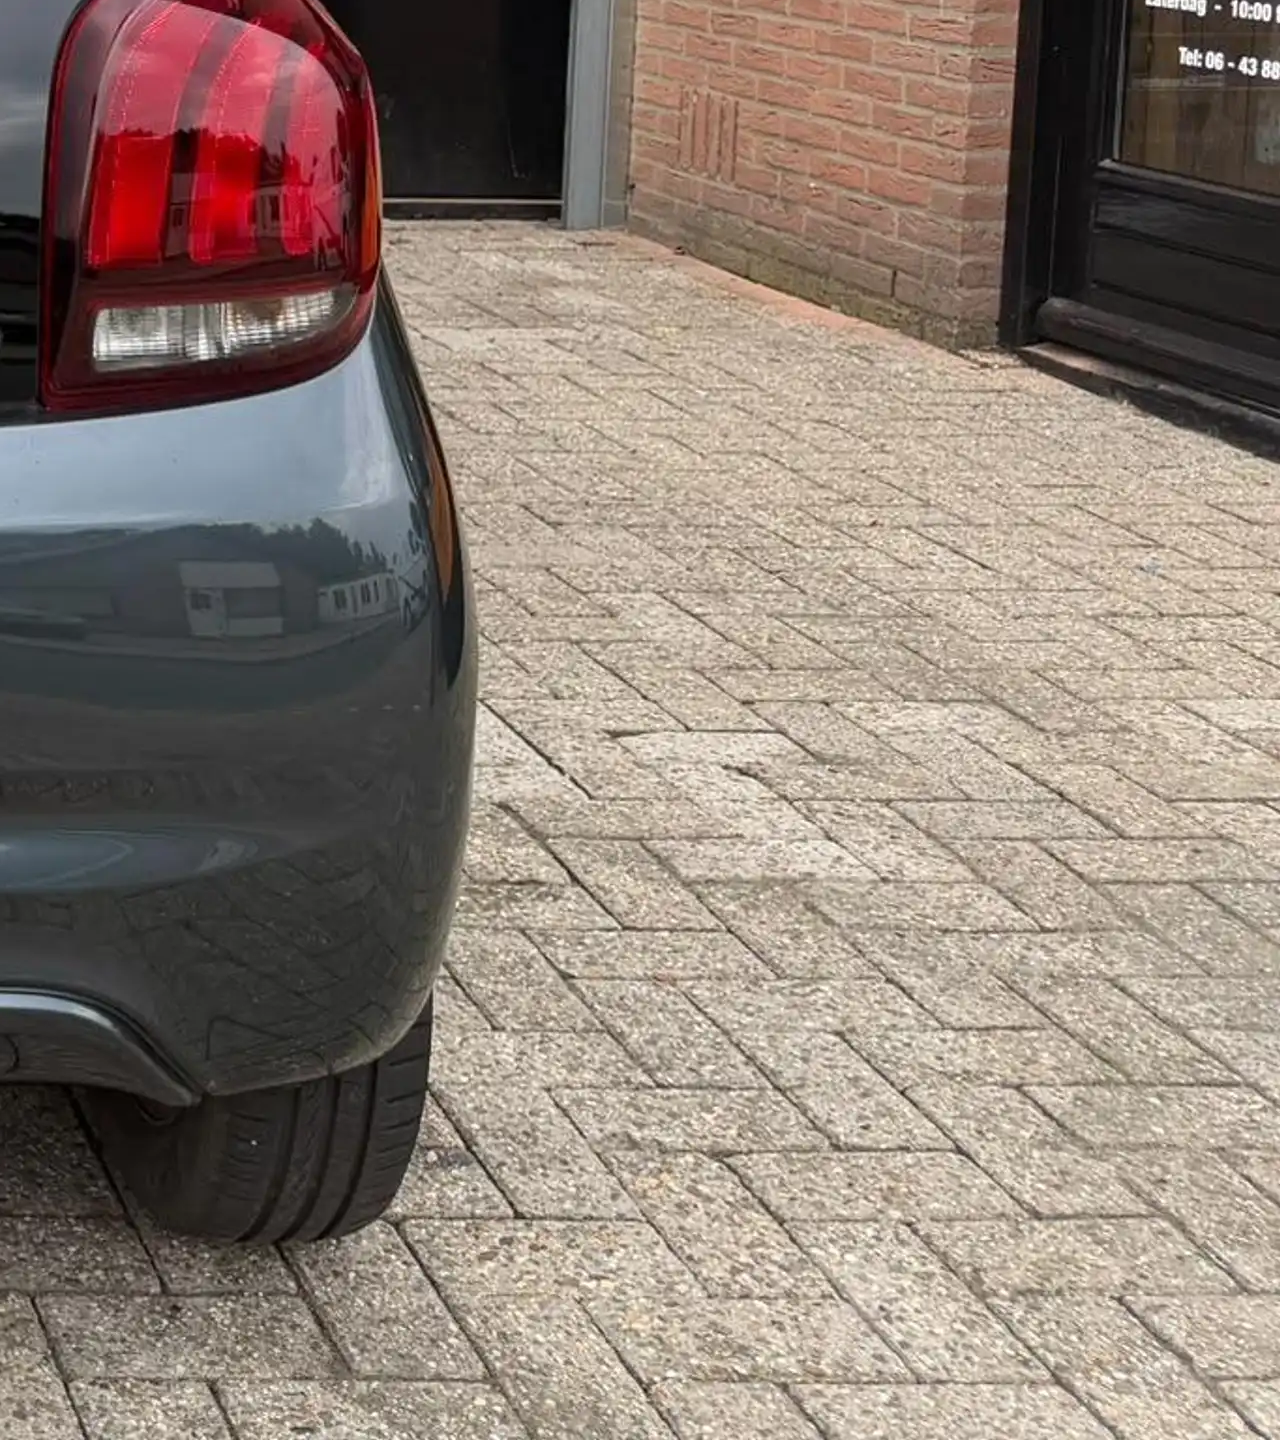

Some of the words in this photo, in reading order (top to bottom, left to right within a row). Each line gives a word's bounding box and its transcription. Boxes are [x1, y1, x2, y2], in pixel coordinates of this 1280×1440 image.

[1178, 46, 1202, 67] Tel:
[1205, 51, 1225, 70] 06
[1238, 56, 1257, 76] 43
